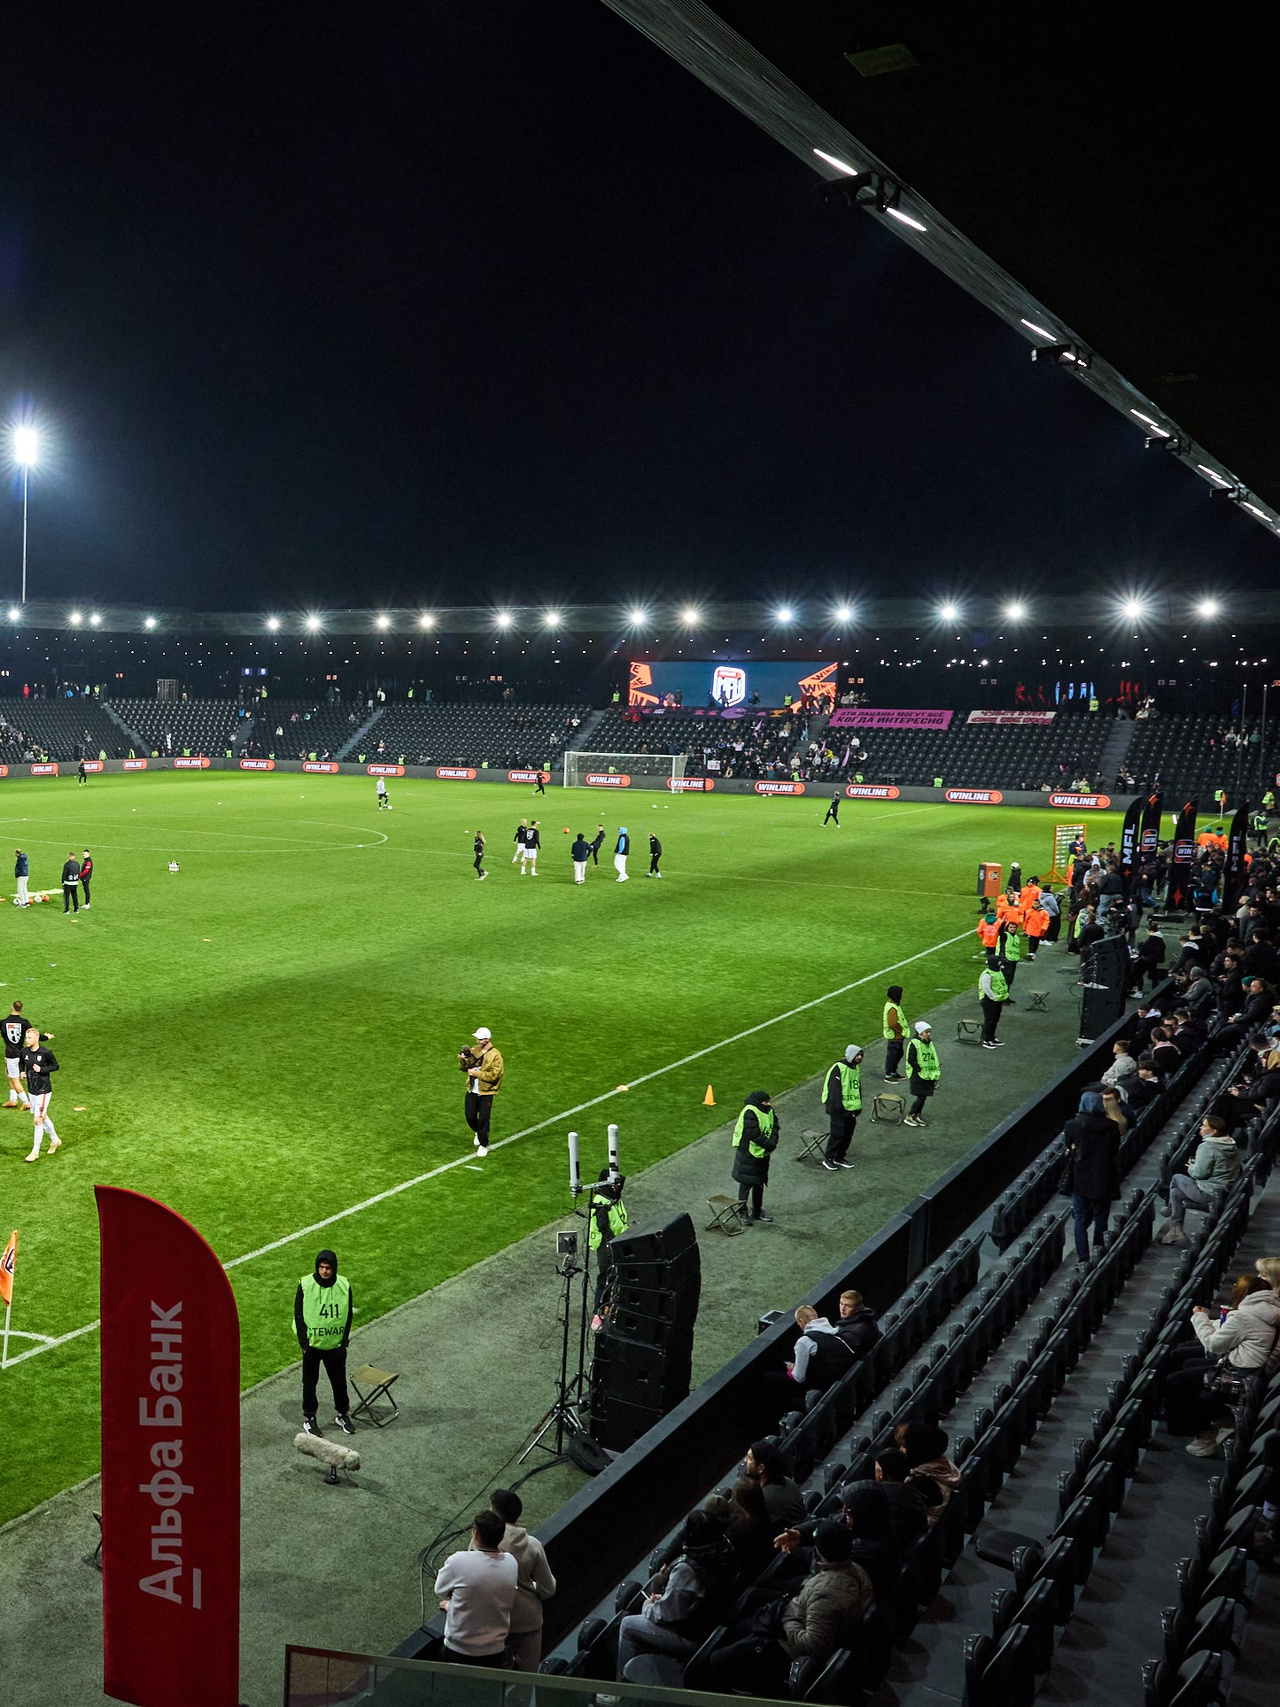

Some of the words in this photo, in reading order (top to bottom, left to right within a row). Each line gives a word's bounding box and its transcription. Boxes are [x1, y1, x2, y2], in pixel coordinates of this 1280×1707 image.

[836, 716, 874, 724] КОГДА
[877, 717, 944, 725] ИНТЕРЕСНО
[370, 766, 397, 774] WINLINE
[440, 769, 468, 777] WINLINE
[590, 776, 620, 785] WINLINE
[759, 784, 794, 792] WINLINE
[850, 787, 888, 796] WINLINE
[950, 792, 990, 800] WINLINE
[1054, 796, 1098, 805] WINLINE
[1122, 823, 1136, 865] MFL
[921, 1052, 935, 1062] 274
[319, 1303, 339, 1319] 411
[139, 1300, 183, 1427] Банк
[139, 1439, 196, 1606] Альфа
